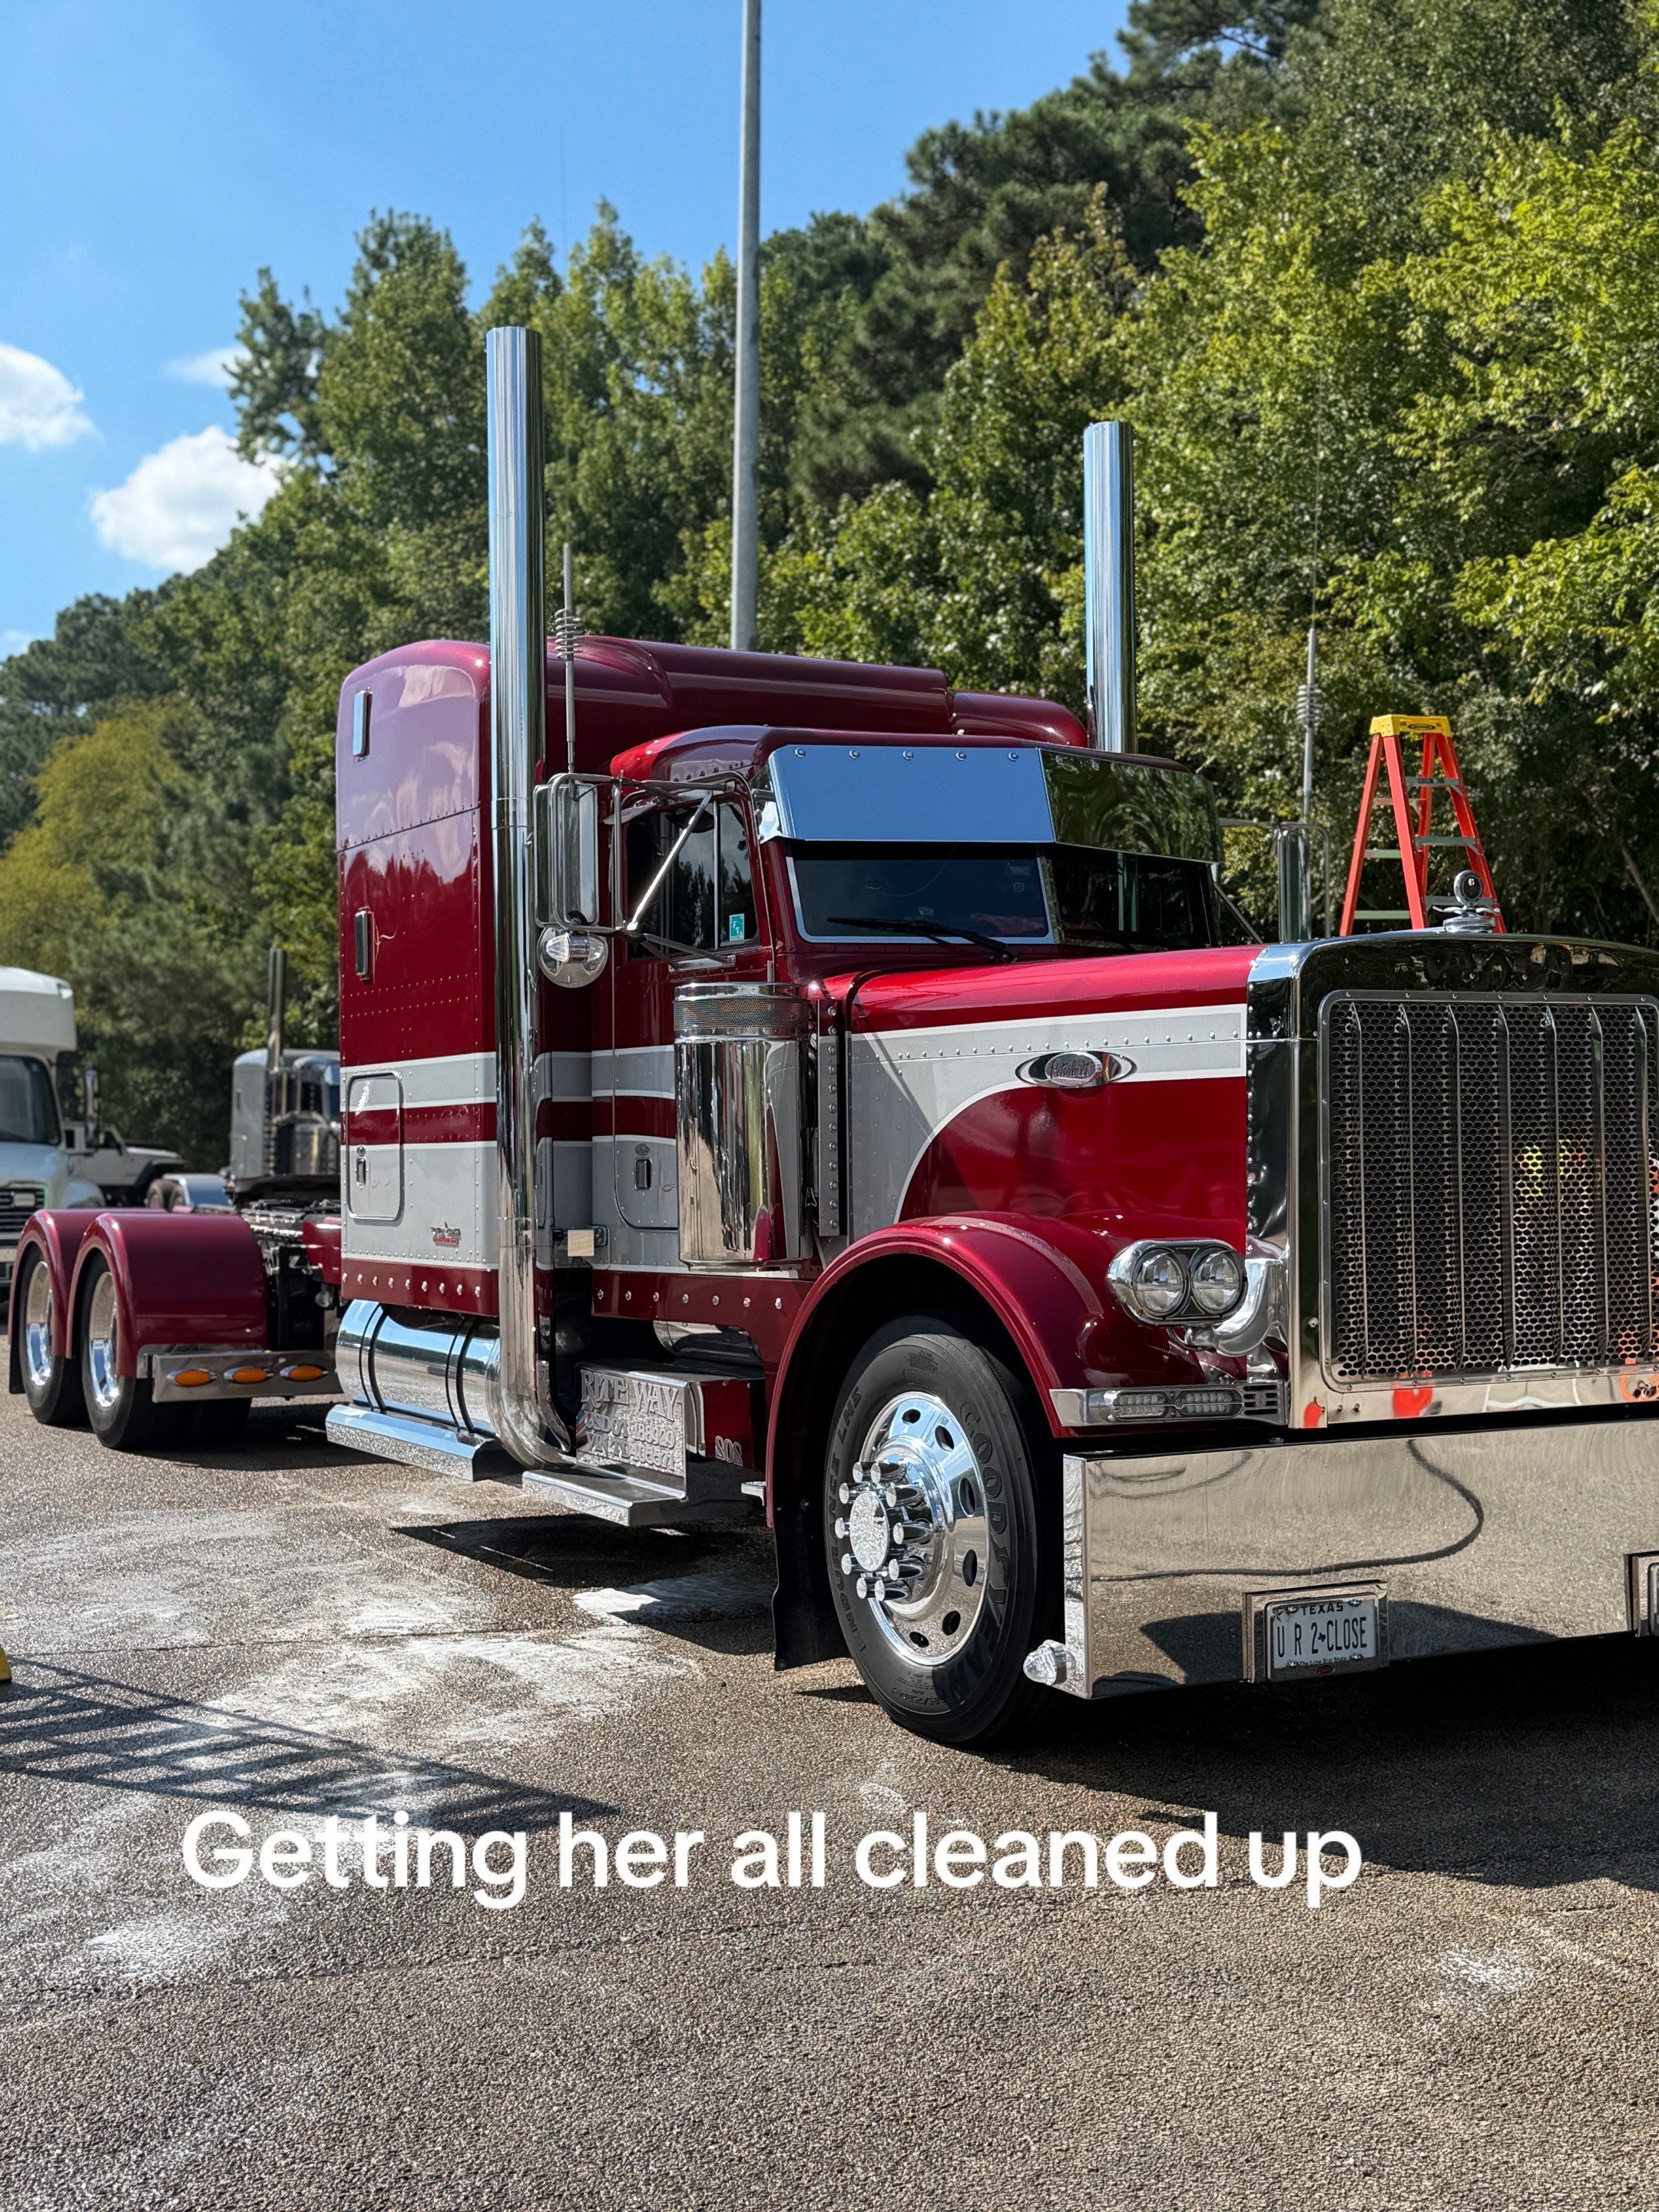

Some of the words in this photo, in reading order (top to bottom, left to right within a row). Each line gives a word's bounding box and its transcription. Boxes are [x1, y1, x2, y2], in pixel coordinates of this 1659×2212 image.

[1050, 1060, 1094, 1078] Peterbilt
[580, 1369, 629, 1409] RITE
[632, 1379, 678, 1422] WAY
[584, 1411, 628, 1438] USDOT
[586, 1432, 609, 1454] VIN
[1301, 1603, 1343, 1615] TEXAS
[1277, 1626, 1284, 1657] U
[1295, 1623, 1302, 1655] R
[1326, 1617, 1367, 1651] CLOSE
